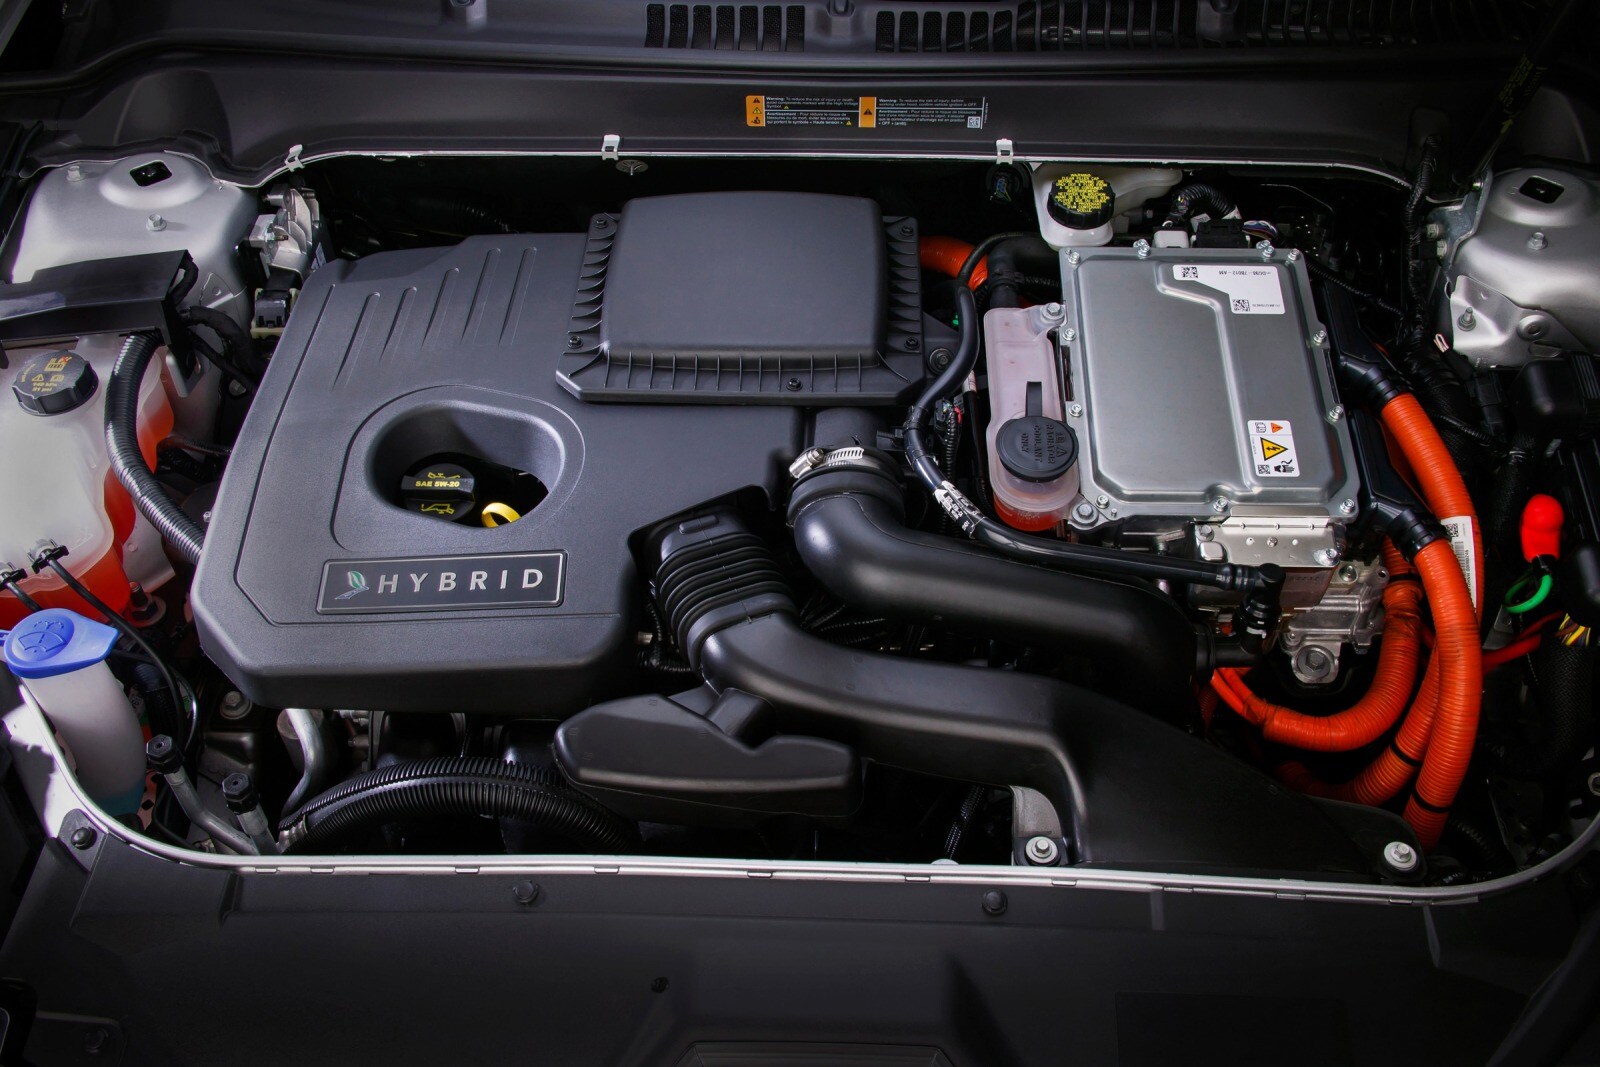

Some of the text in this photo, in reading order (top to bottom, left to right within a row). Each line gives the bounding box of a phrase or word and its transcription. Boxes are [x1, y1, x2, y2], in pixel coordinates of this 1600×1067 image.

[1021, 433, 1029, 453] ONLY
[1033, 425, 1042, 462] COOLANT
[1046, 424, 1055, 464] RADIATOR
[378, 568, 544, 594] HYBRID
